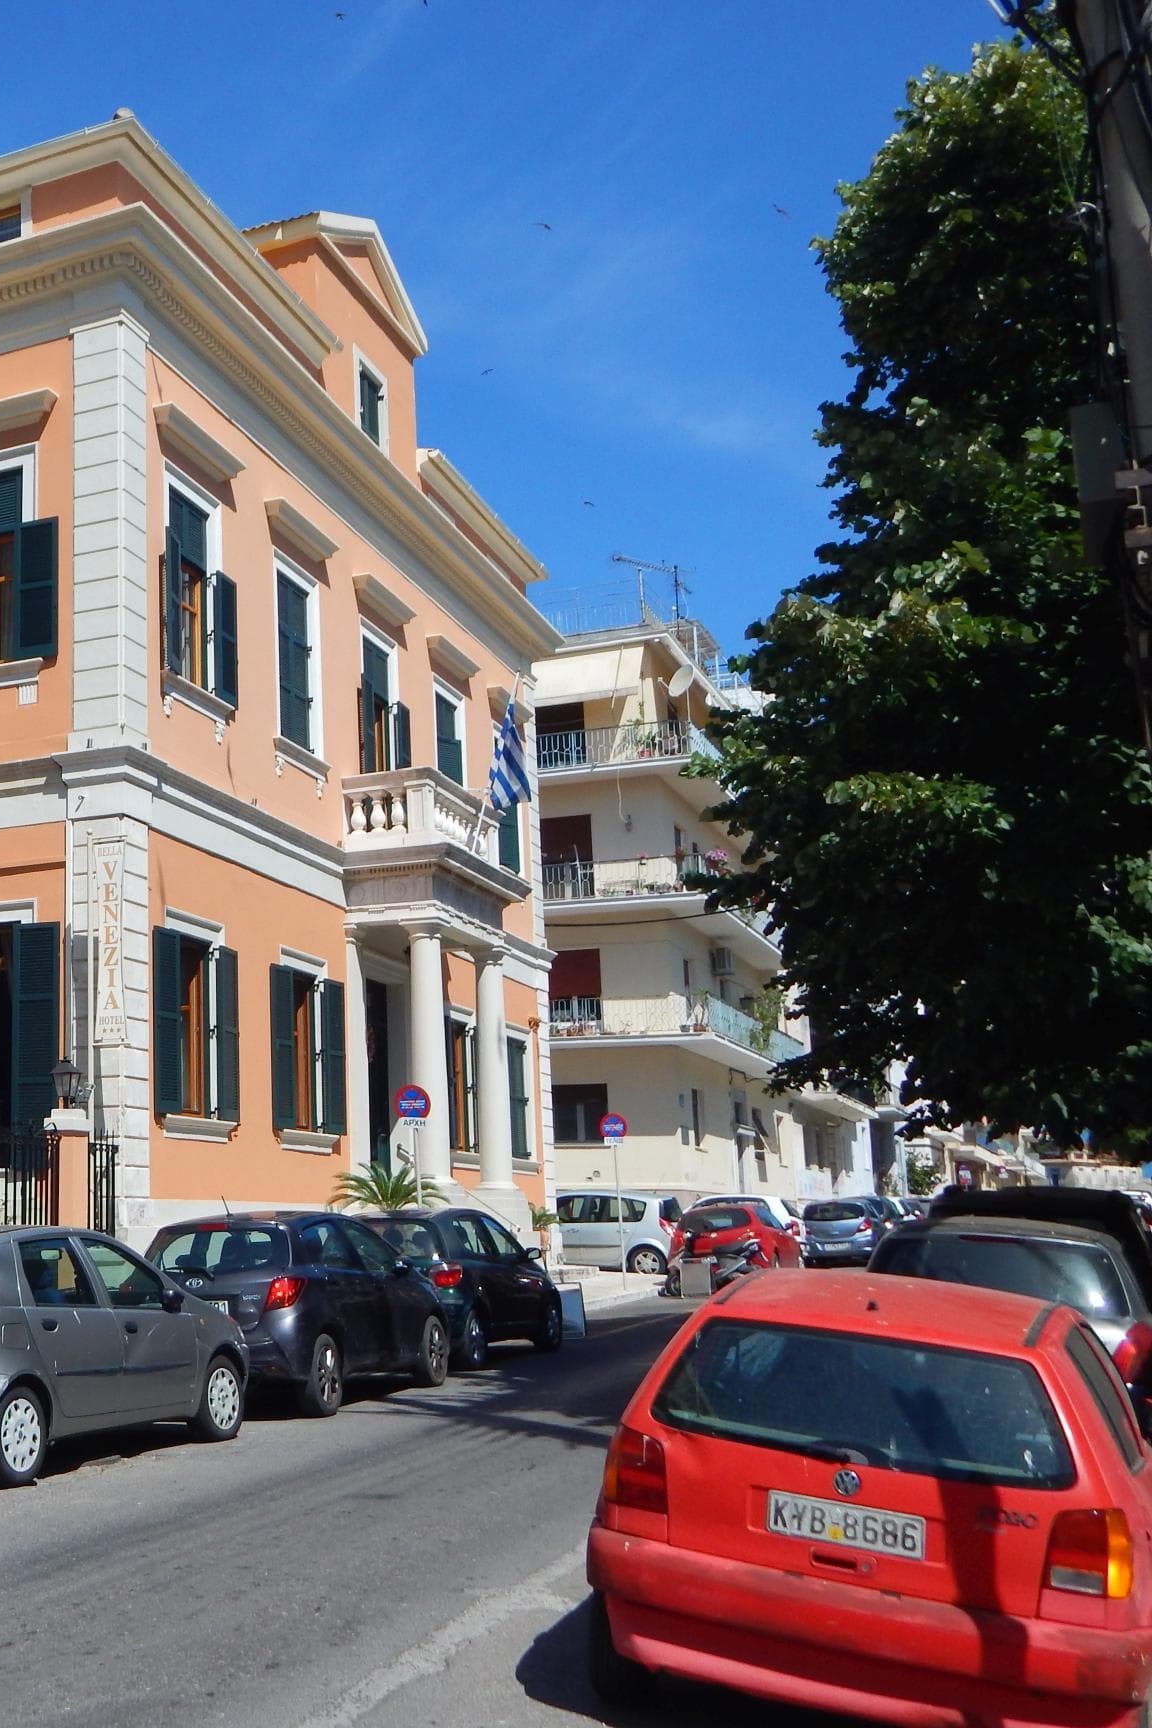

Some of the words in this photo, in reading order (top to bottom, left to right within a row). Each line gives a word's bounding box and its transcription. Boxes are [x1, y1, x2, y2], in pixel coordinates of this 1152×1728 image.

[97, 846, 122, 857] BELLA
[102, 860, 120, 1010] VENEZIA
[98, 1015, 125, 1025] HOTEL
